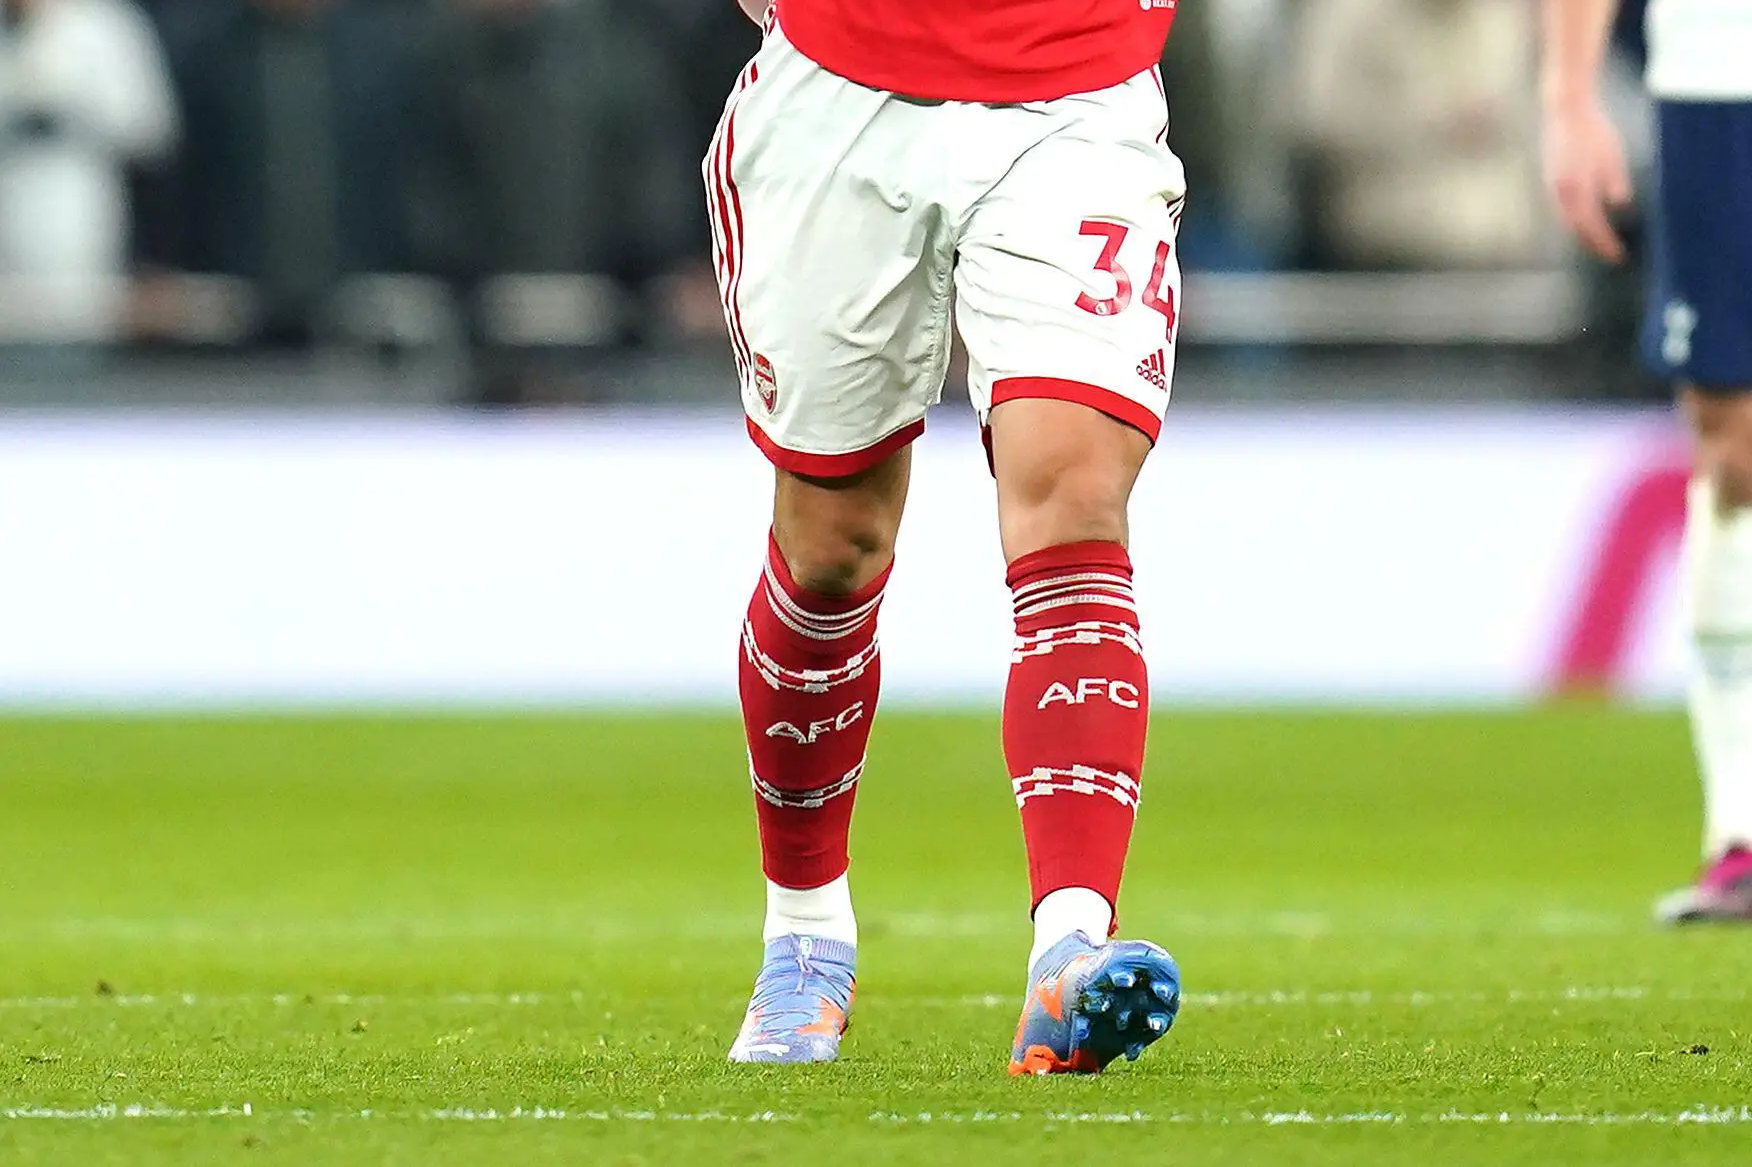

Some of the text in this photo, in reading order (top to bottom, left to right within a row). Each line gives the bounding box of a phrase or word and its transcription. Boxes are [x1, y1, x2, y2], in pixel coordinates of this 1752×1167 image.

[1074, 219, 1176, 345] 34
[1036, 677, 1139, 710] AFC
[766, 700, 864, 744] AFC
